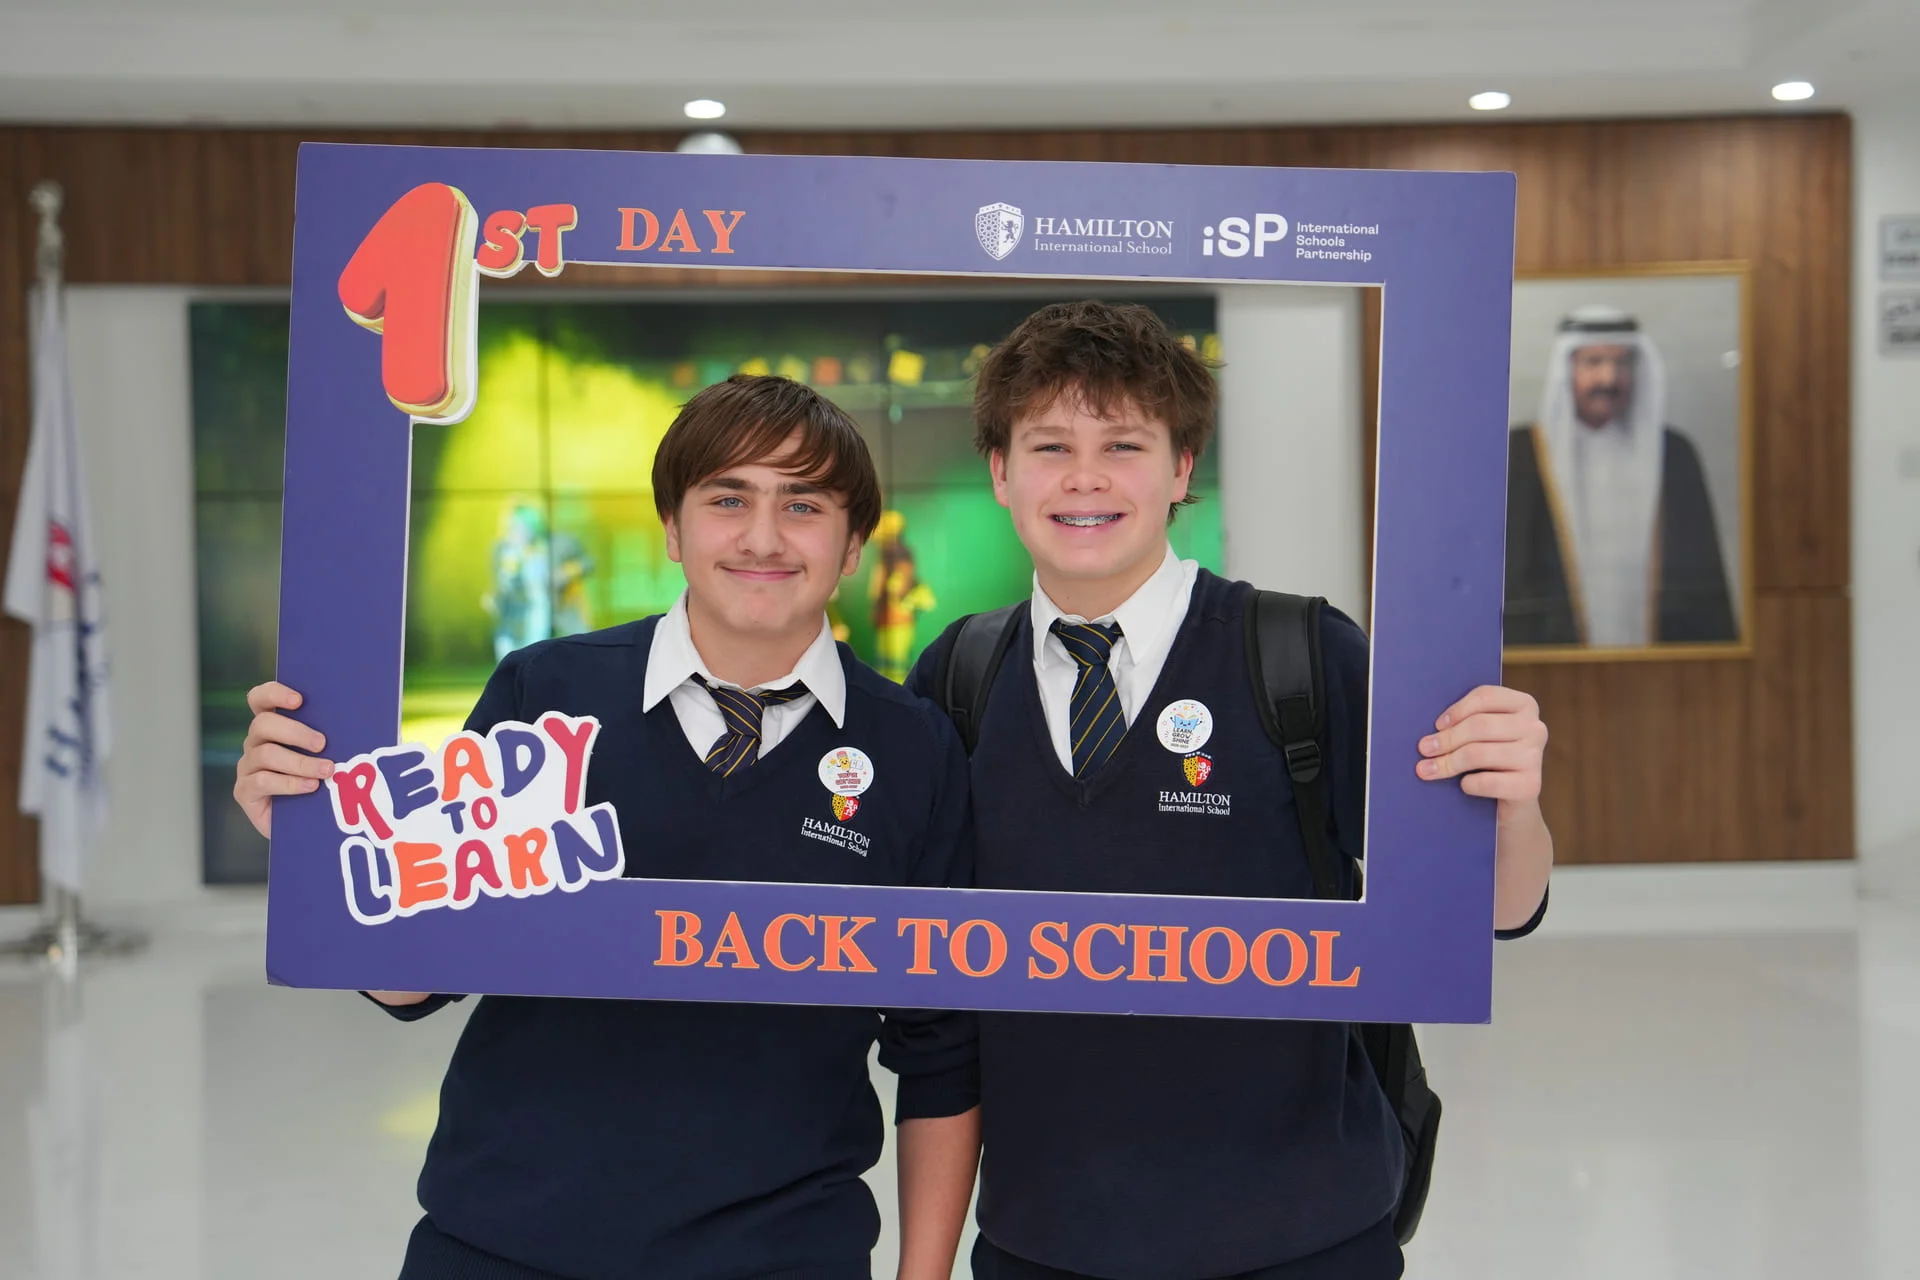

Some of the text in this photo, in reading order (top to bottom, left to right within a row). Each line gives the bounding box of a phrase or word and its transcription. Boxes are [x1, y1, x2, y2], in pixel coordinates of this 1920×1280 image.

[1034, 217, 1175, 239] HAMILTON
[1202, 213, 1288, 258] iSP
[1296, 222, 1379, 235] International
[1296, 235, 1345, 247] Schools
[1034, 238, 1173, 255] International School
[1296, 248, 1372, 262] Partnership
[338, 182, 746, 418] 1ST DAY
[332, 717, 594, 841] READY
[1158, 803, 1230, 816] International School
[1159, 790, 1231, 807] HAMILTON
[440, 796, 498, 834] TO
[801, 827, 868, 857] International School
[803, 817, 871, 849] HAMILTON
[349, 808, 619, 917] LEARN
[653, 909, 1361, 989] BACK TO SCHOOL
